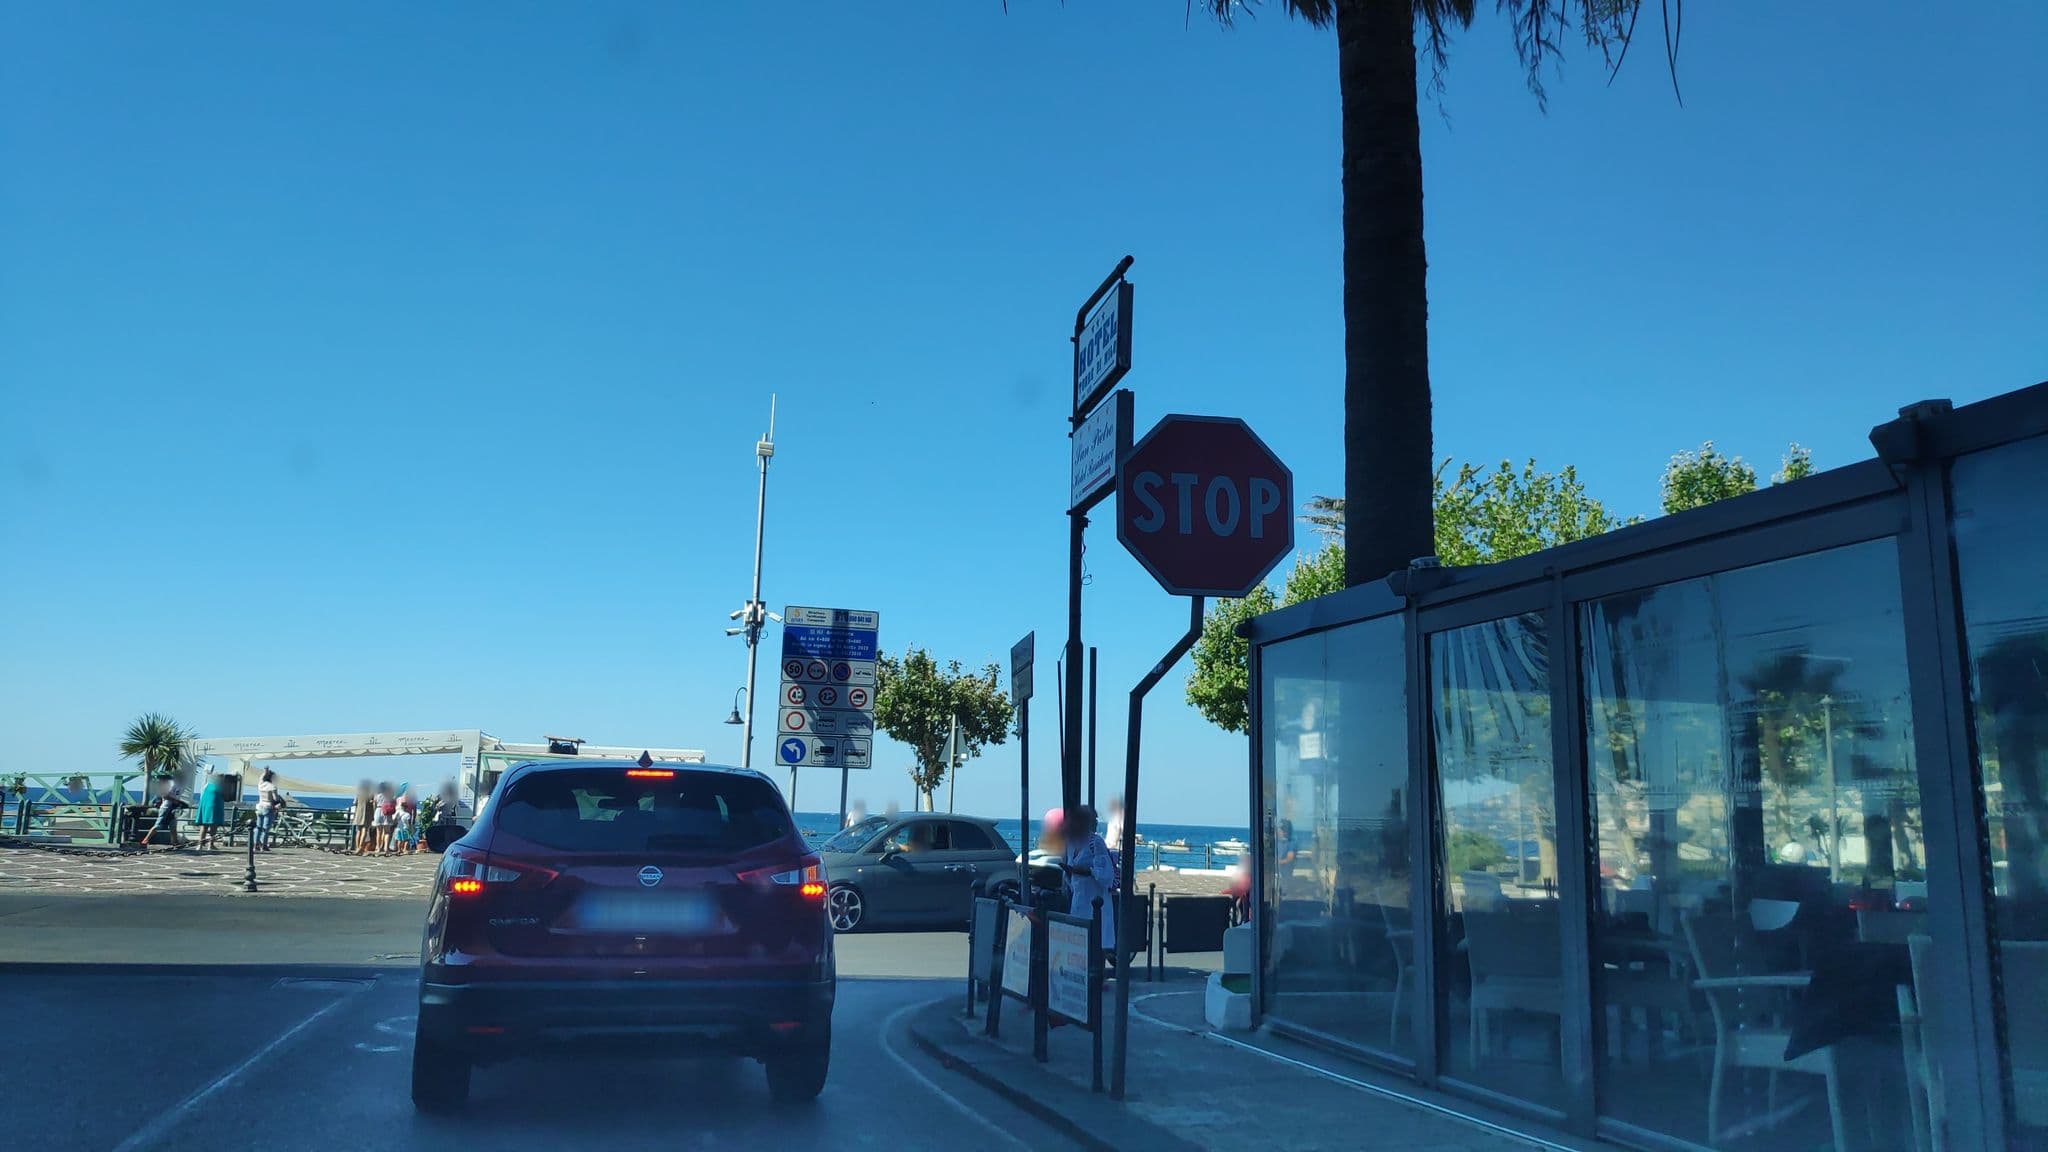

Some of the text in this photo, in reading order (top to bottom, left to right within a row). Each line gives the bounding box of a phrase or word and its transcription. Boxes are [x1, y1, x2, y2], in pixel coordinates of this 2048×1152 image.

[1080, 311, 1117, 377] HOTEL
[1133, 471, 1281, 539] STOP
[789, 665, 800, 674] 50
